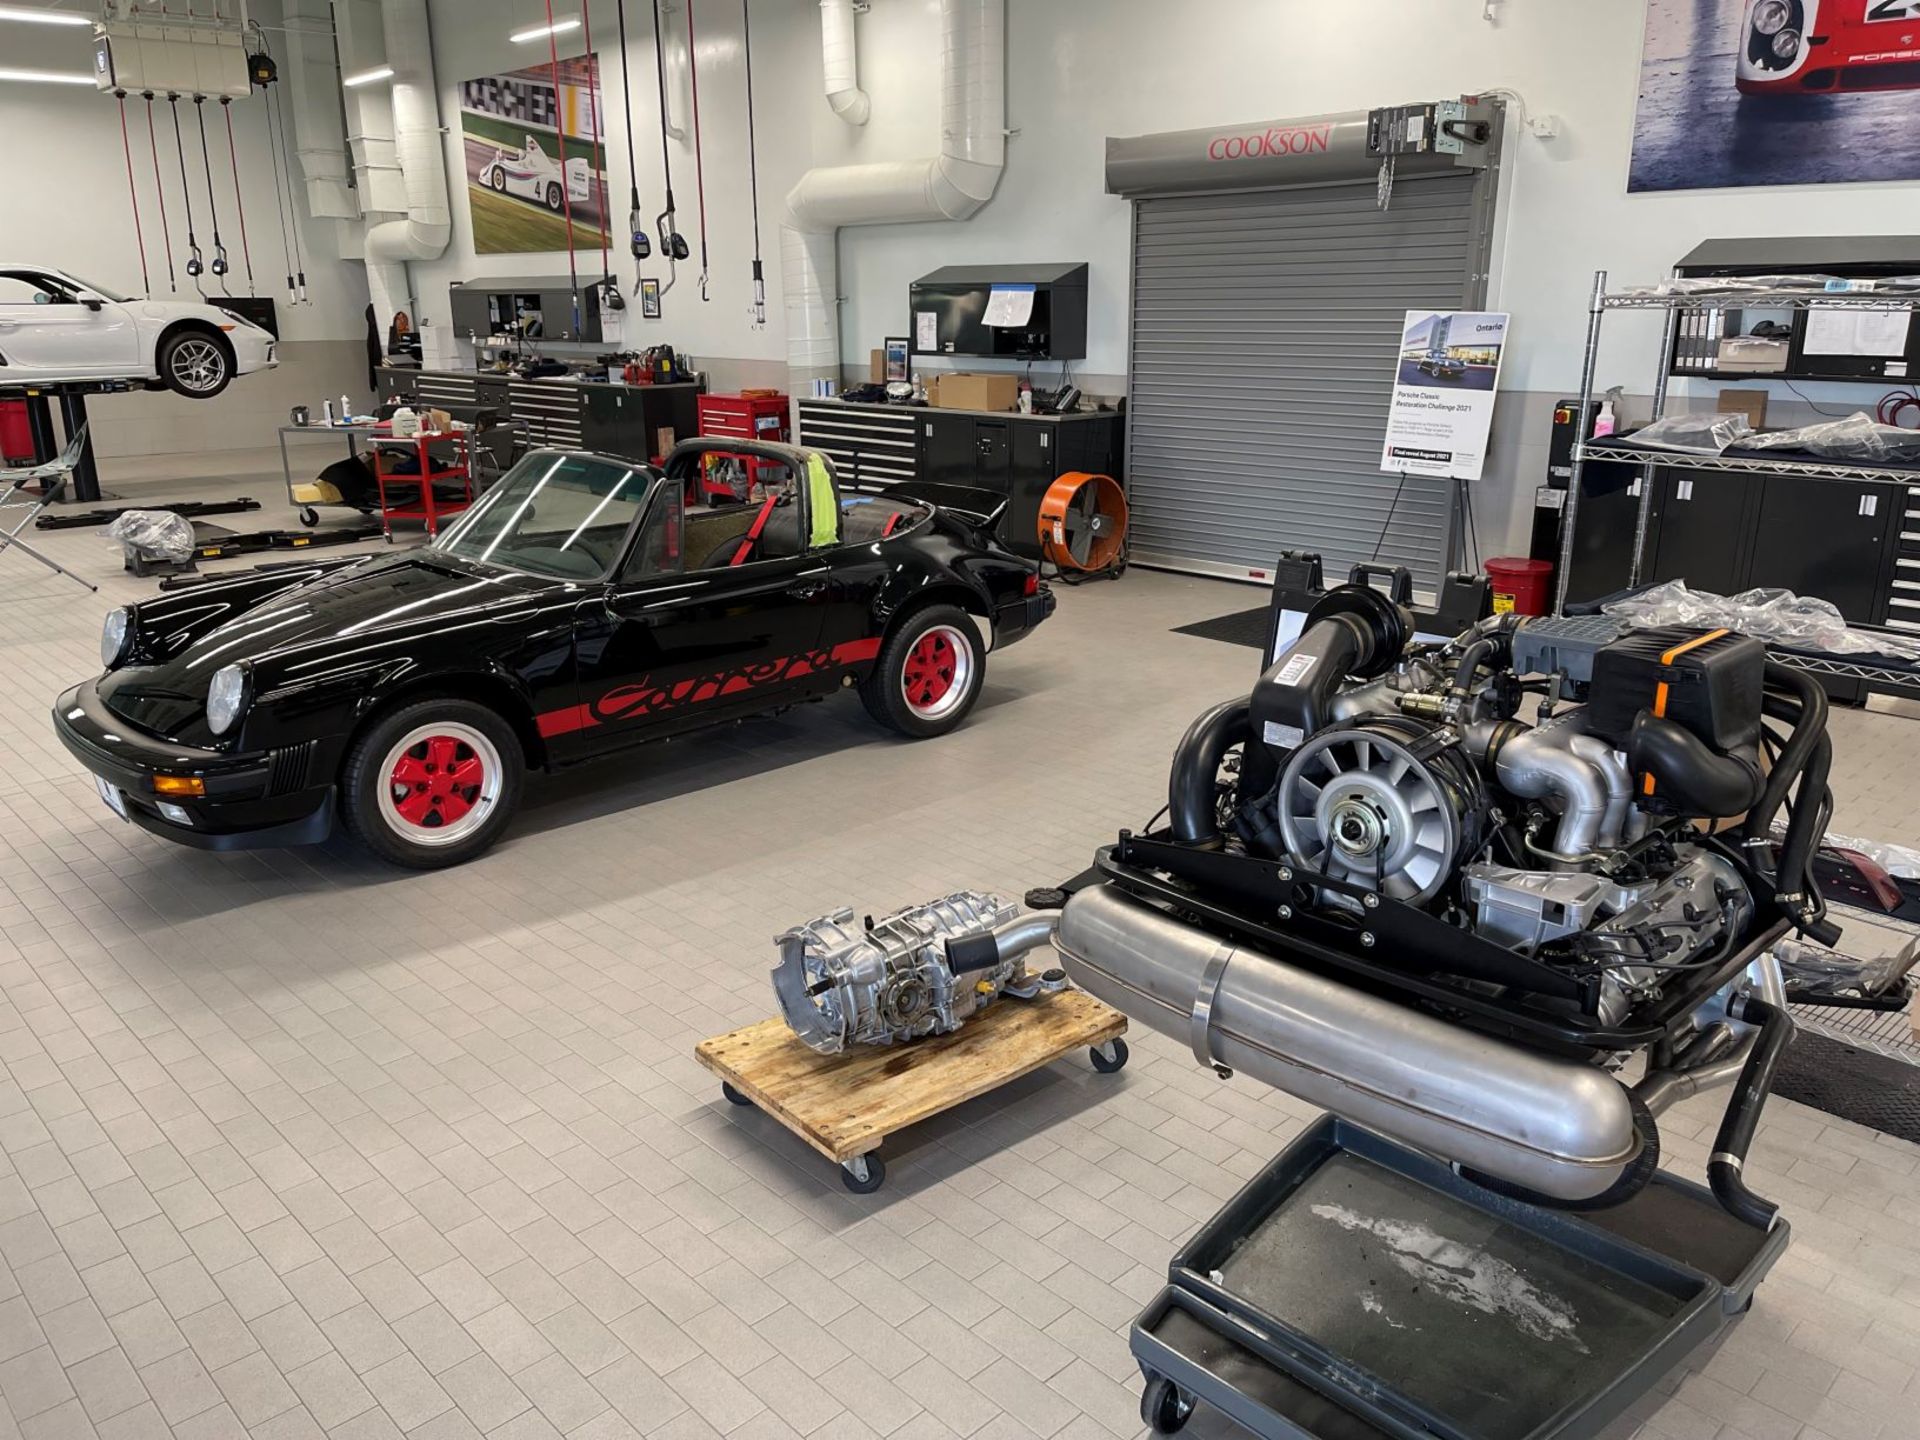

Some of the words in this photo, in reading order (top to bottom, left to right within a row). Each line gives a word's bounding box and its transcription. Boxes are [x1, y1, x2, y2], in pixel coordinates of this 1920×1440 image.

[1209, 128, 1330, 160] COOKSON
[534, 181, 541, 198] 4
[1475, 323, 1503, 332] Ontario
[1397, 391, 1419, 399] Porsche
[1420, 392, 1440, 400] Classic
[1396, 401, 1427, 409] Restoration
[1428, 403, 1456, 412] Challenge
[1420, 451, 1436, 460] August
[590, 648, 840, 720] Carrera
